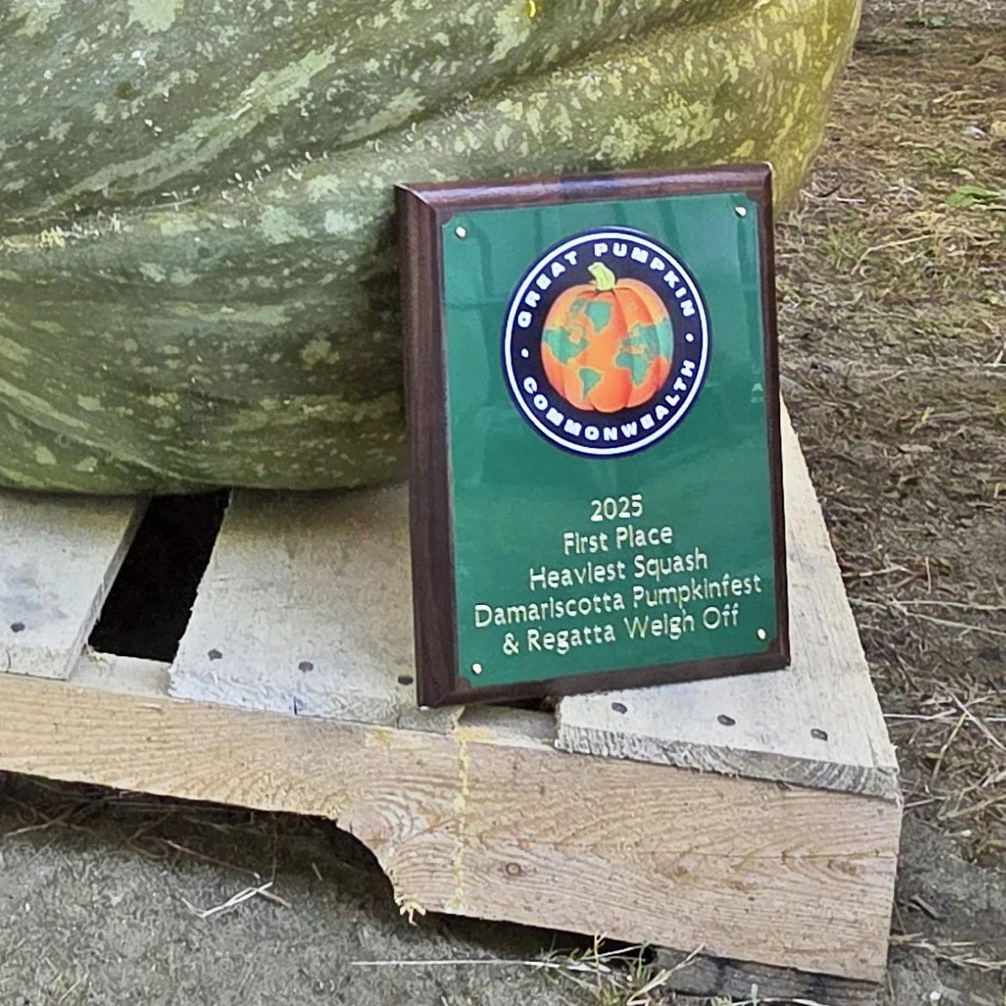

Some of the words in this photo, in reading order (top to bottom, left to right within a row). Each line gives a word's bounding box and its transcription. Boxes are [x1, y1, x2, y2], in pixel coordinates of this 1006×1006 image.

[517, 251, 578, 328] GREAT
[594, 242, 696, 317] PUMPKIN
[522, 359, 696, 441] COMMONWEALTH
[590, 494, 643, 522] 2025
[563, 531, 609, 556] First
[615, 524, 673, 550] Place
[529, 560, 626, 590] Heaviest
[634, 547, 708, 582] Squash
[474, 592, 625, 628] Damariscotta
[632, 573, 762, 609] Pumpkinfest
[502, 633, 519, 655] &
[527, 624, 616, 655] Regatta
[624, 609, 694, 640] Weigh
[703, 603, 739, 629] Off
